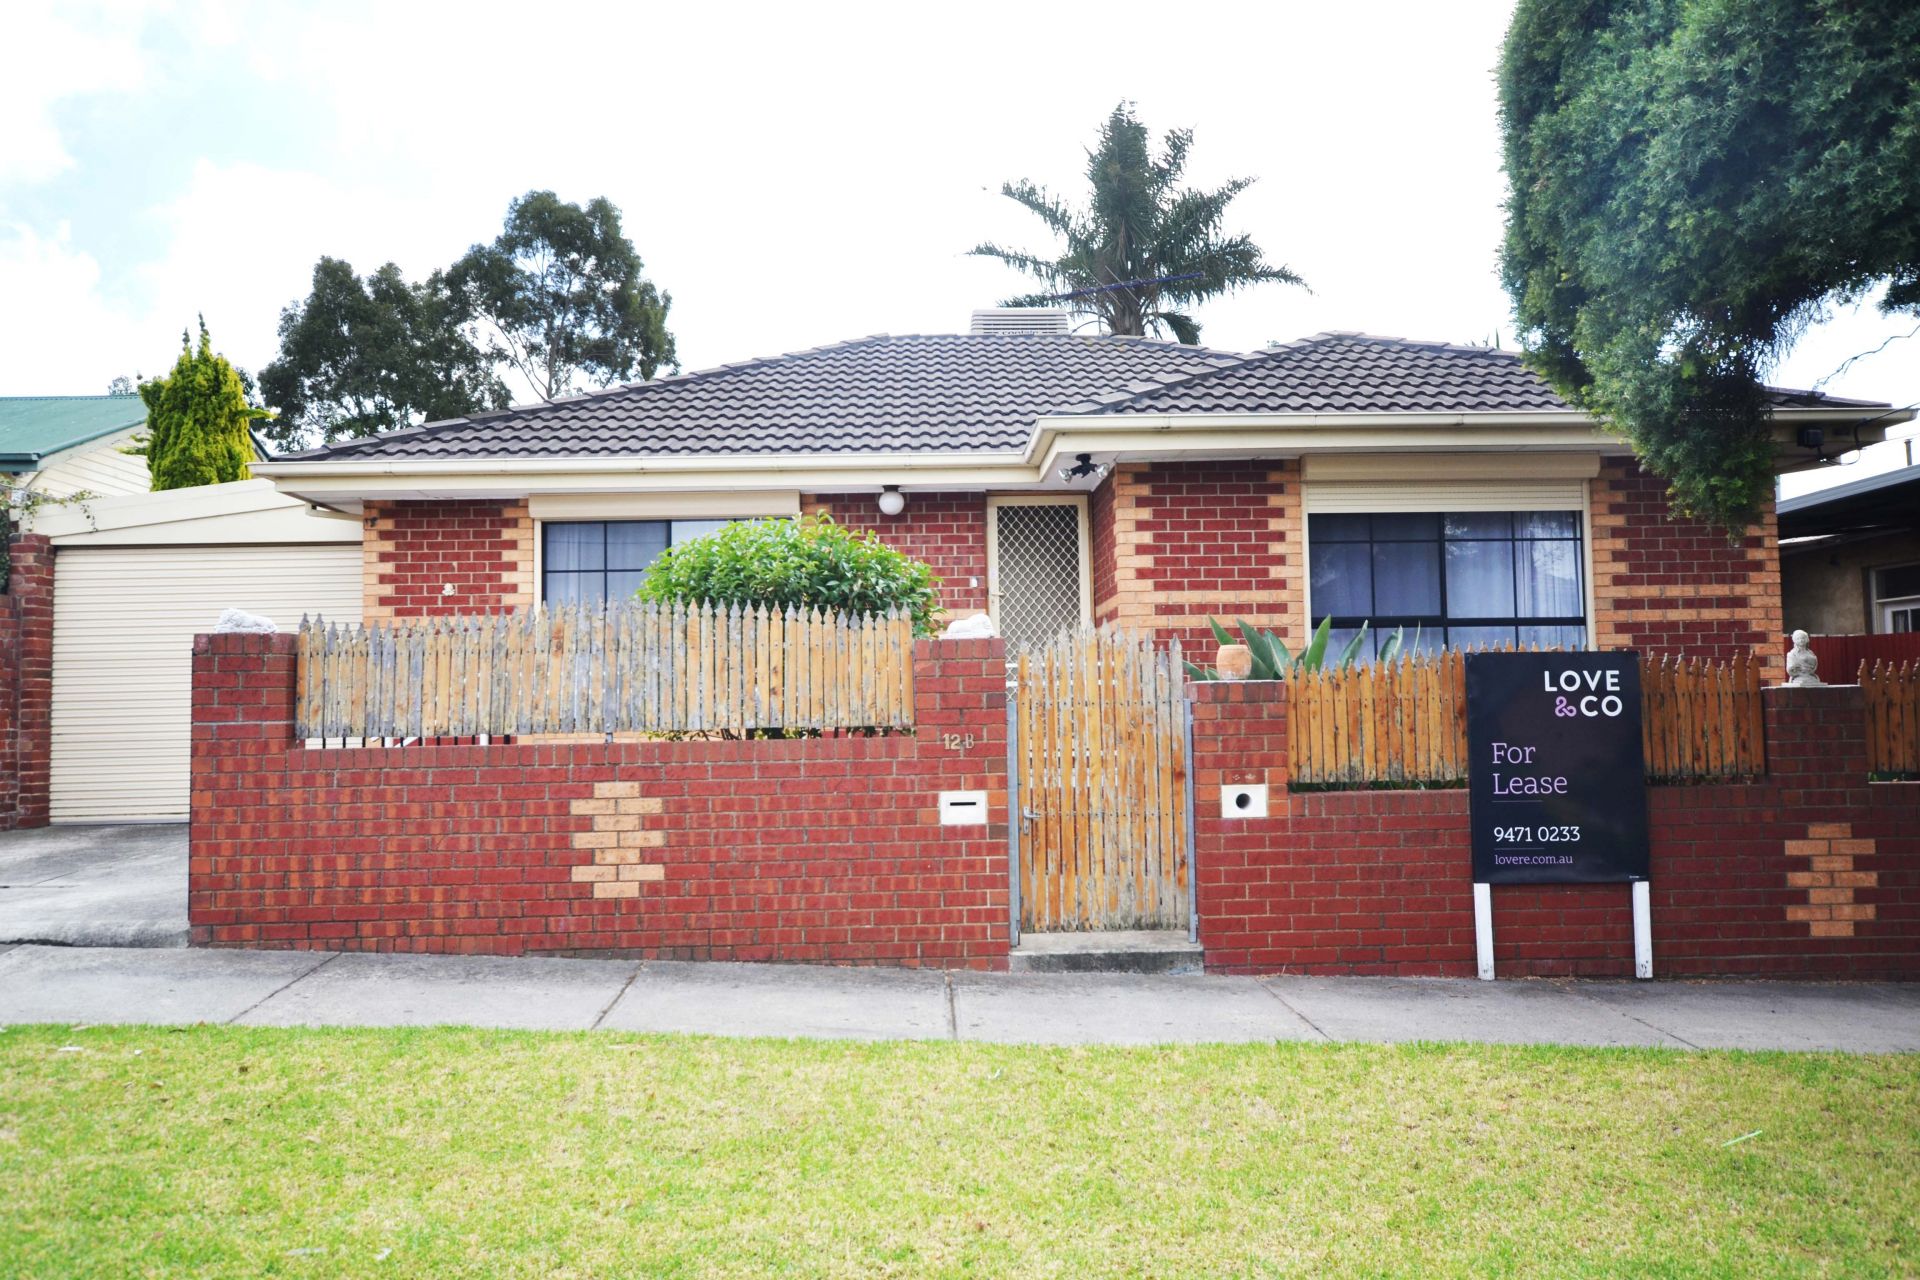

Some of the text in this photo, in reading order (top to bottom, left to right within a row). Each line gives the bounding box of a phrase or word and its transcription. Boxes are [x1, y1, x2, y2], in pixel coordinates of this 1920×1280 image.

[1544, 670, 1620, 692] LOVE
[1491, 742, 1536, 764] For
[1493, 773, 1568, 795] Lease
[1493, 826, 1581, 843] 9471 0233
[1494, 854, 1574, 865] lovere.com.au
